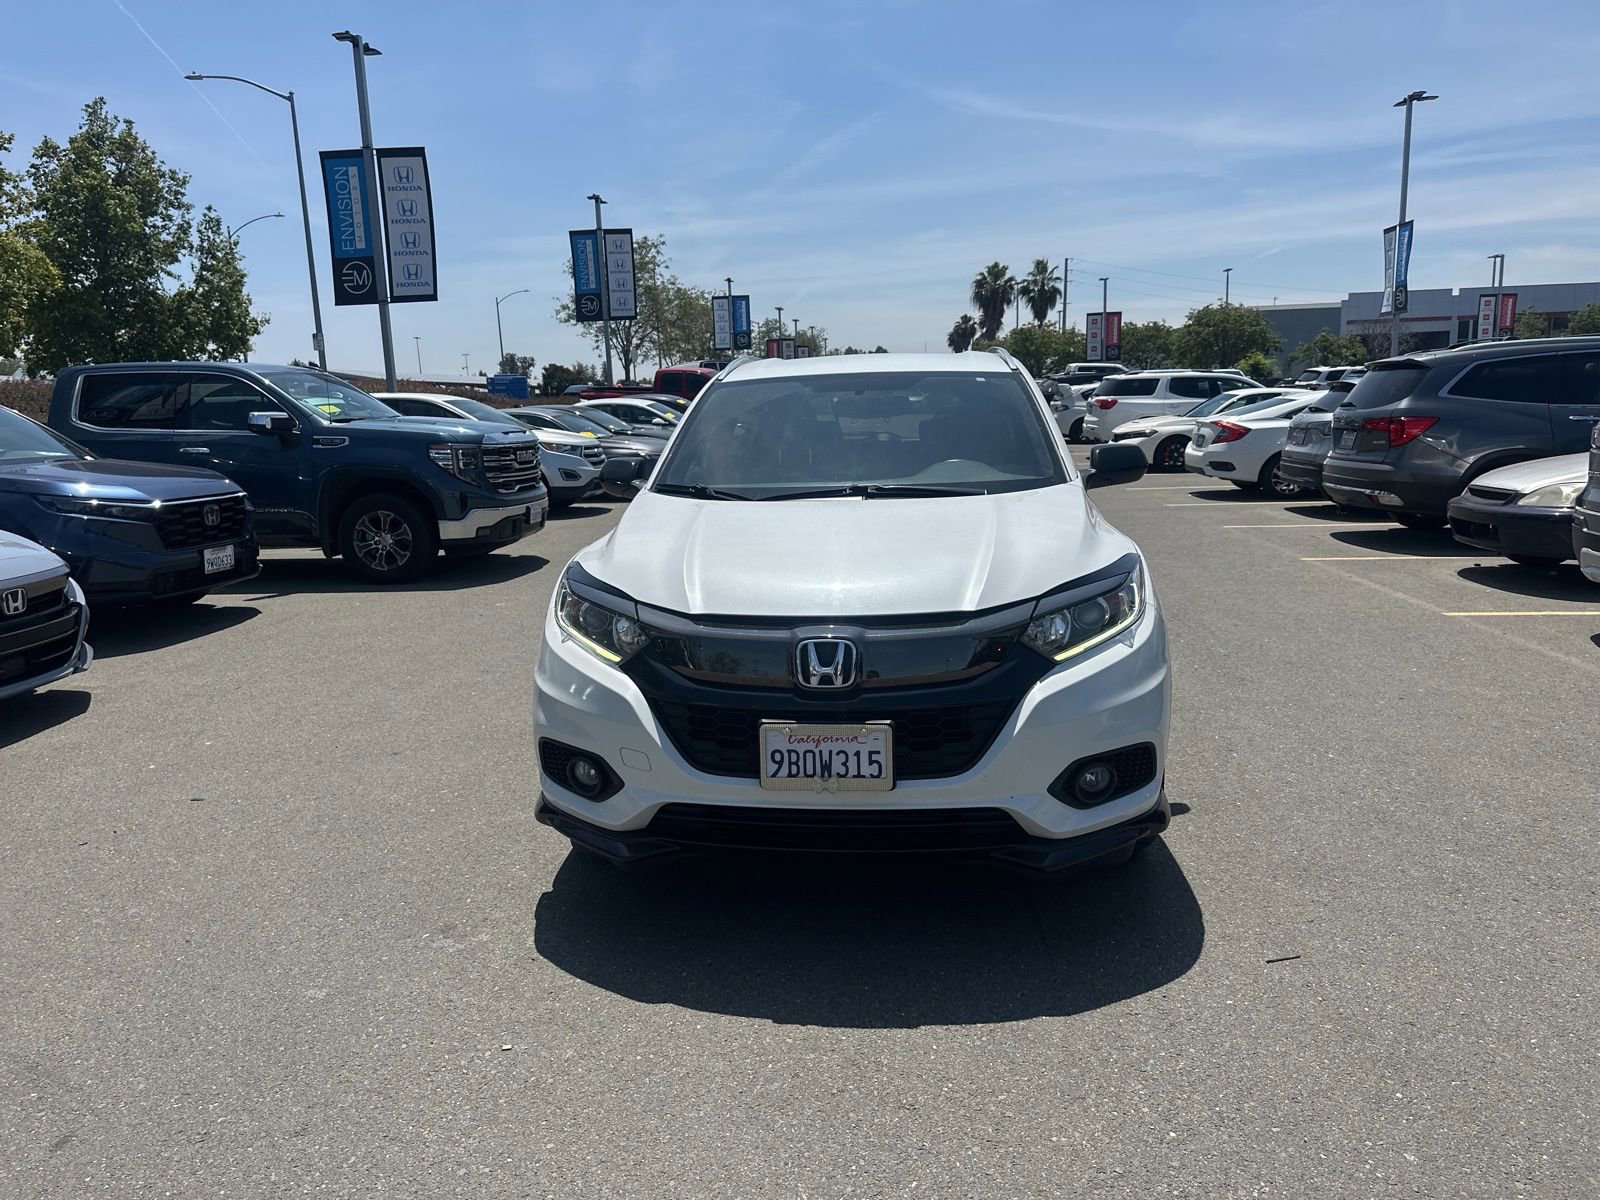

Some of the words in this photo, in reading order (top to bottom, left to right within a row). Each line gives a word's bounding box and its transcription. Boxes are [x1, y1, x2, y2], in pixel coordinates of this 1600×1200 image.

[334, 166, 356, 250] ENVISION
[352, 173, 364, 243] MOTORS
[391, 217, 427, 225] HONDA
[577, 239, 590, 290] ENVISION
[788, 735, 867, 748] California
